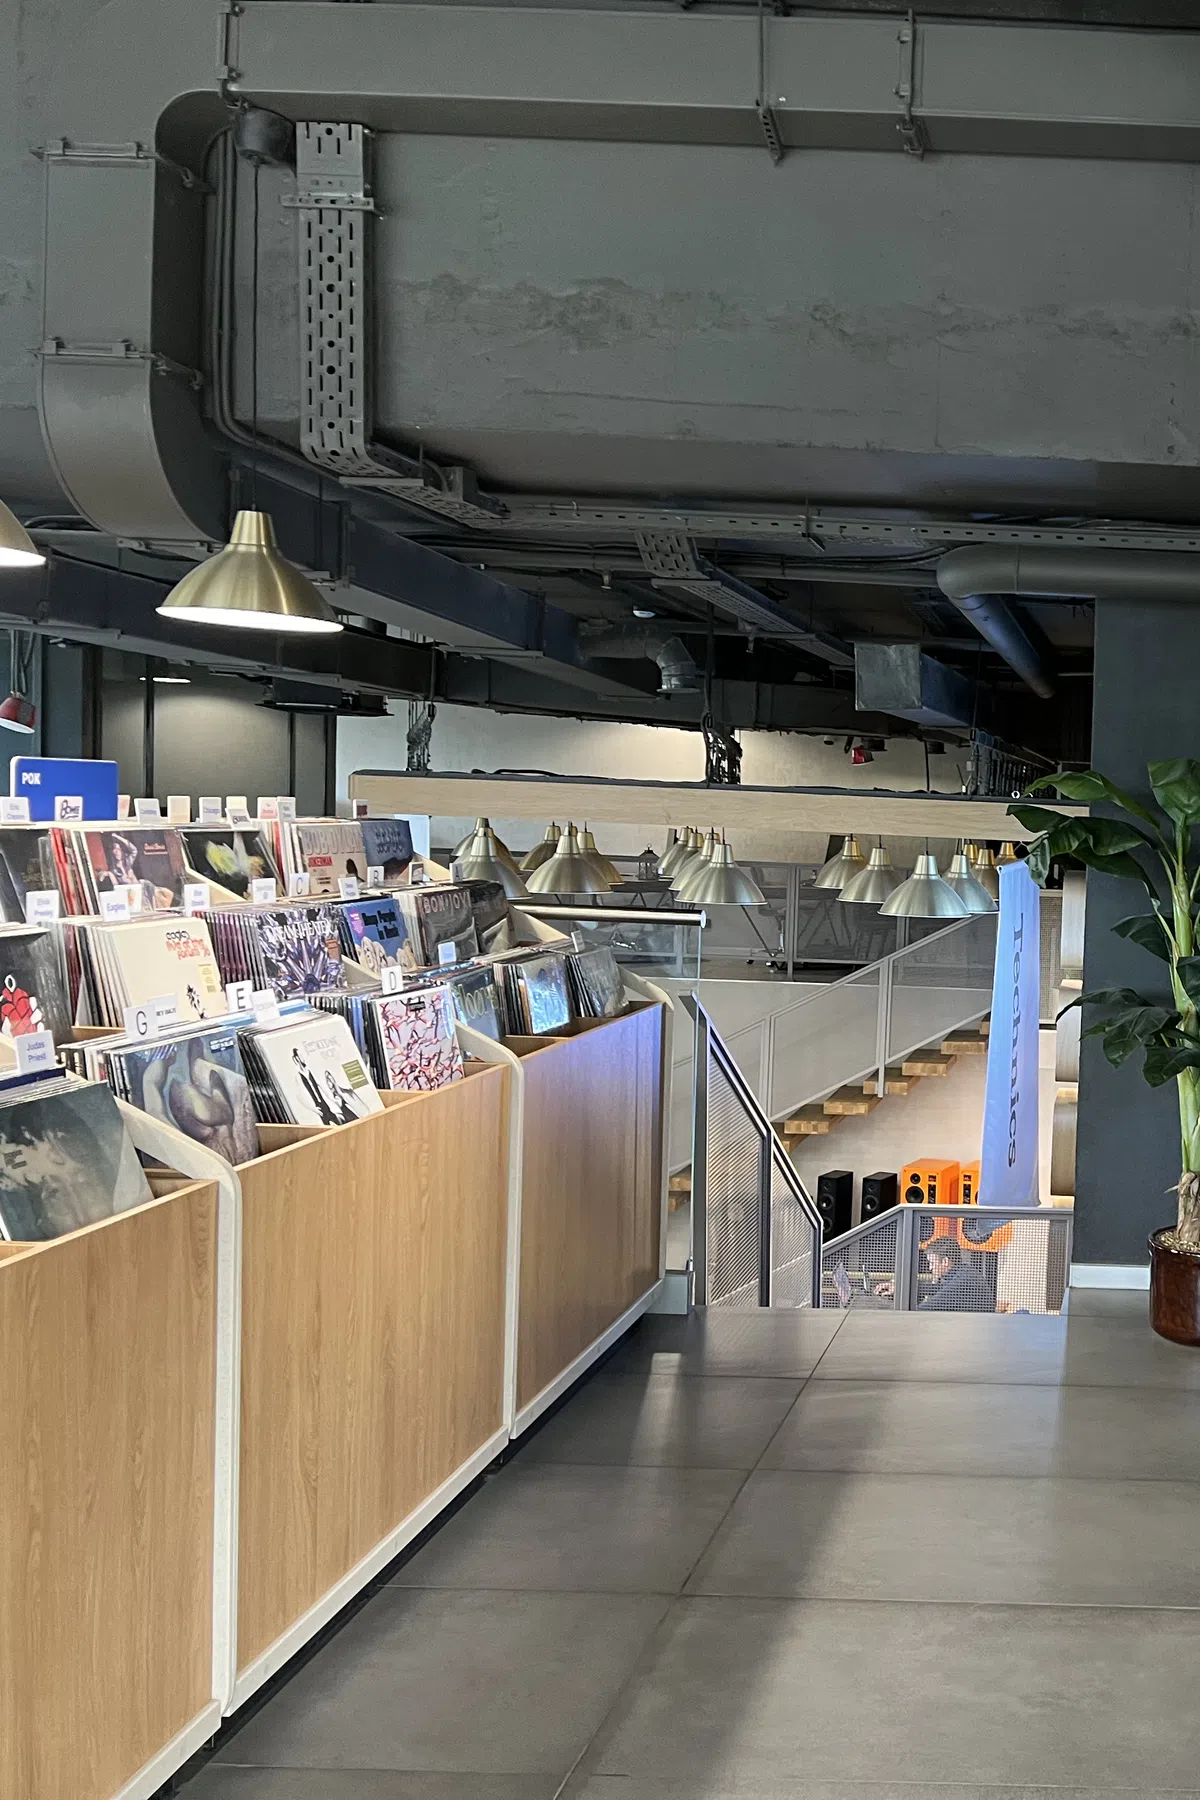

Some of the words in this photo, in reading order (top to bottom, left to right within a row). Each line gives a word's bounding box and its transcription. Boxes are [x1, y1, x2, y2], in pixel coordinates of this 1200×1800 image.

[423, 894, 446, 913] BON
[389, 971, 397, 991] D
[236, 987, 246, 1009] E
[136, 1010, 148, 1036] G
[27, 1041, 45, 1051] Judas
[1008, 913, 1024, 1168] Technics
[28, 1053, 47, 1064] Priest
